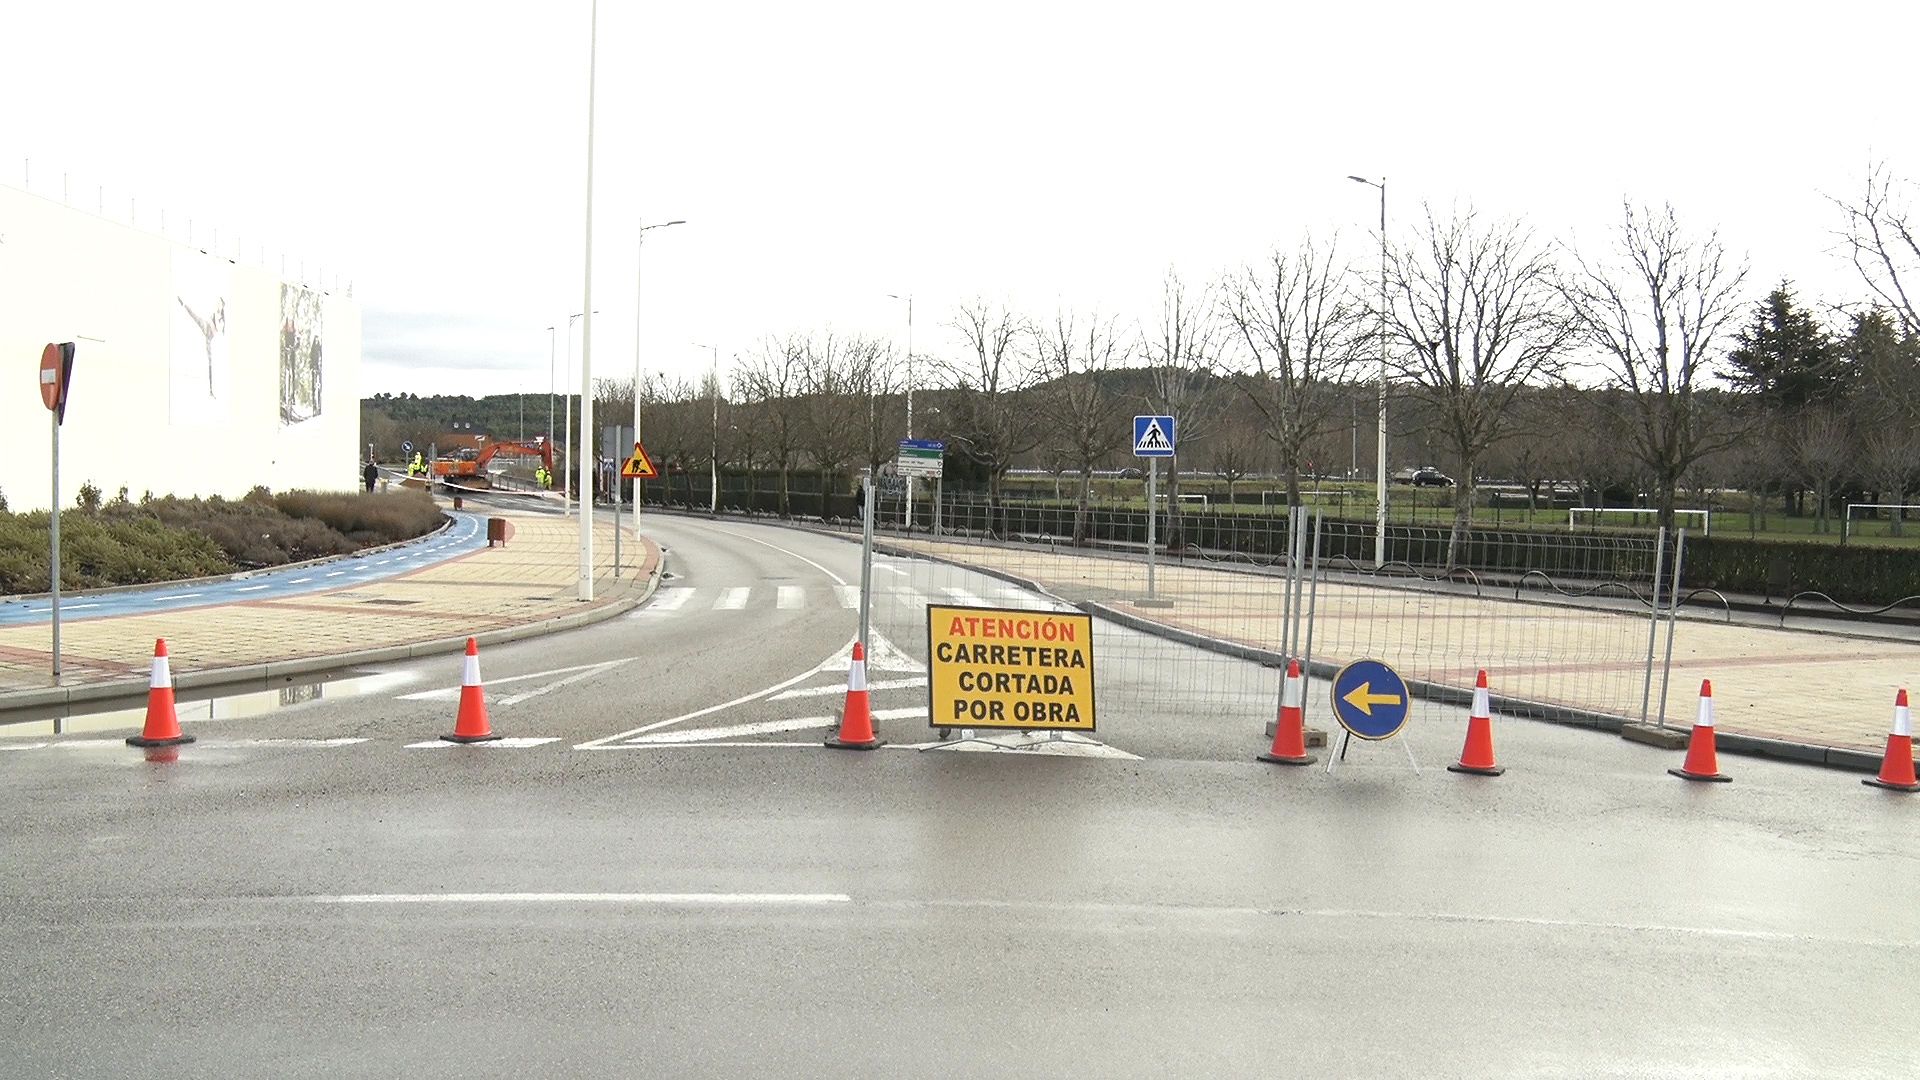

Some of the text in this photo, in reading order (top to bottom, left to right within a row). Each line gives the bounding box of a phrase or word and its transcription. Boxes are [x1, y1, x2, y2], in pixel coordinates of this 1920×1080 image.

[949, 617, 1075, 642] ATENCIÓN
[937, 642, 1086, 668] CARRETERA
[959, 671, 1075, 695] CORTADA
[954, 699, 1081, 723] POR OBRA
